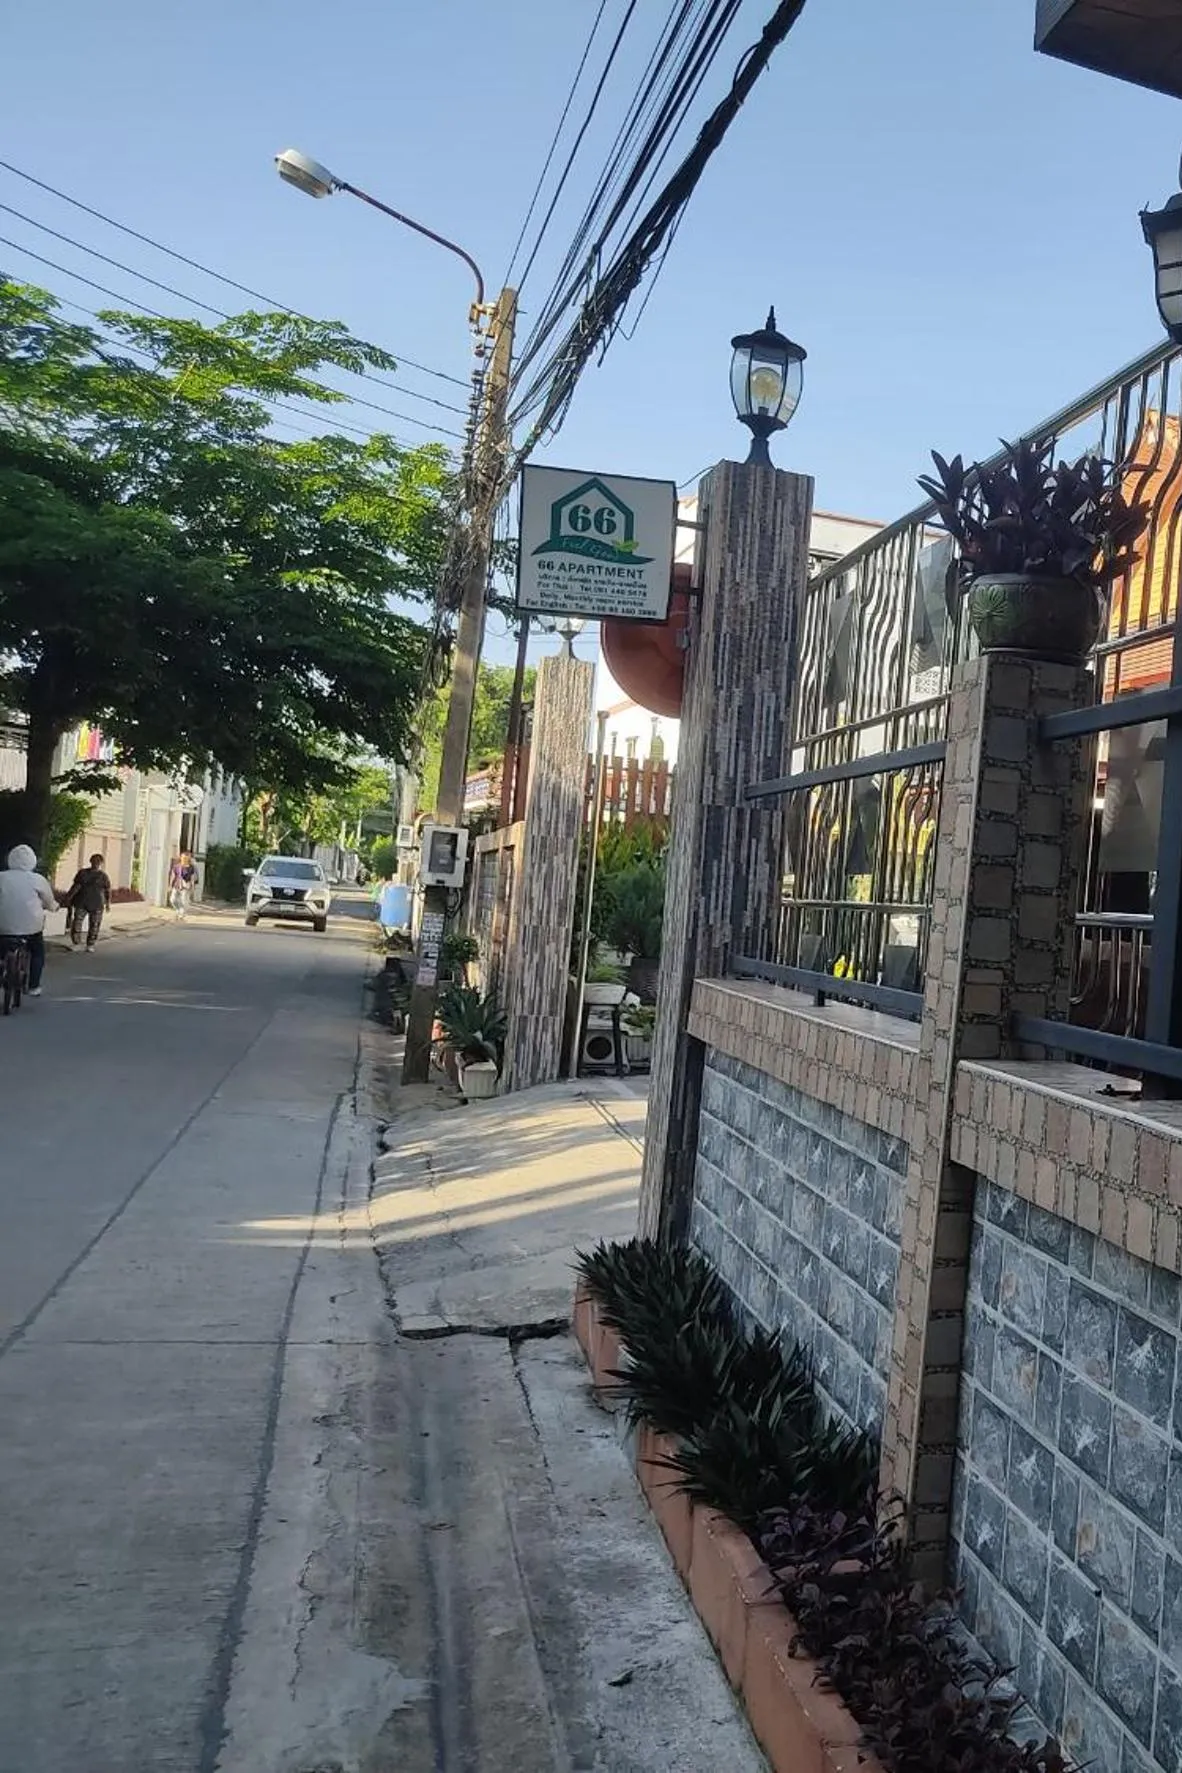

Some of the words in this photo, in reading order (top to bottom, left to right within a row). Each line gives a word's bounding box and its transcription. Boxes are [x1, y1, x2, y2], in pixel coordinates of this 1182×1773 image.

[568, 504, 617, 535] 66
[537, 559, 555, 571] 66
[557, 561, 645, 579] APARTMENT
